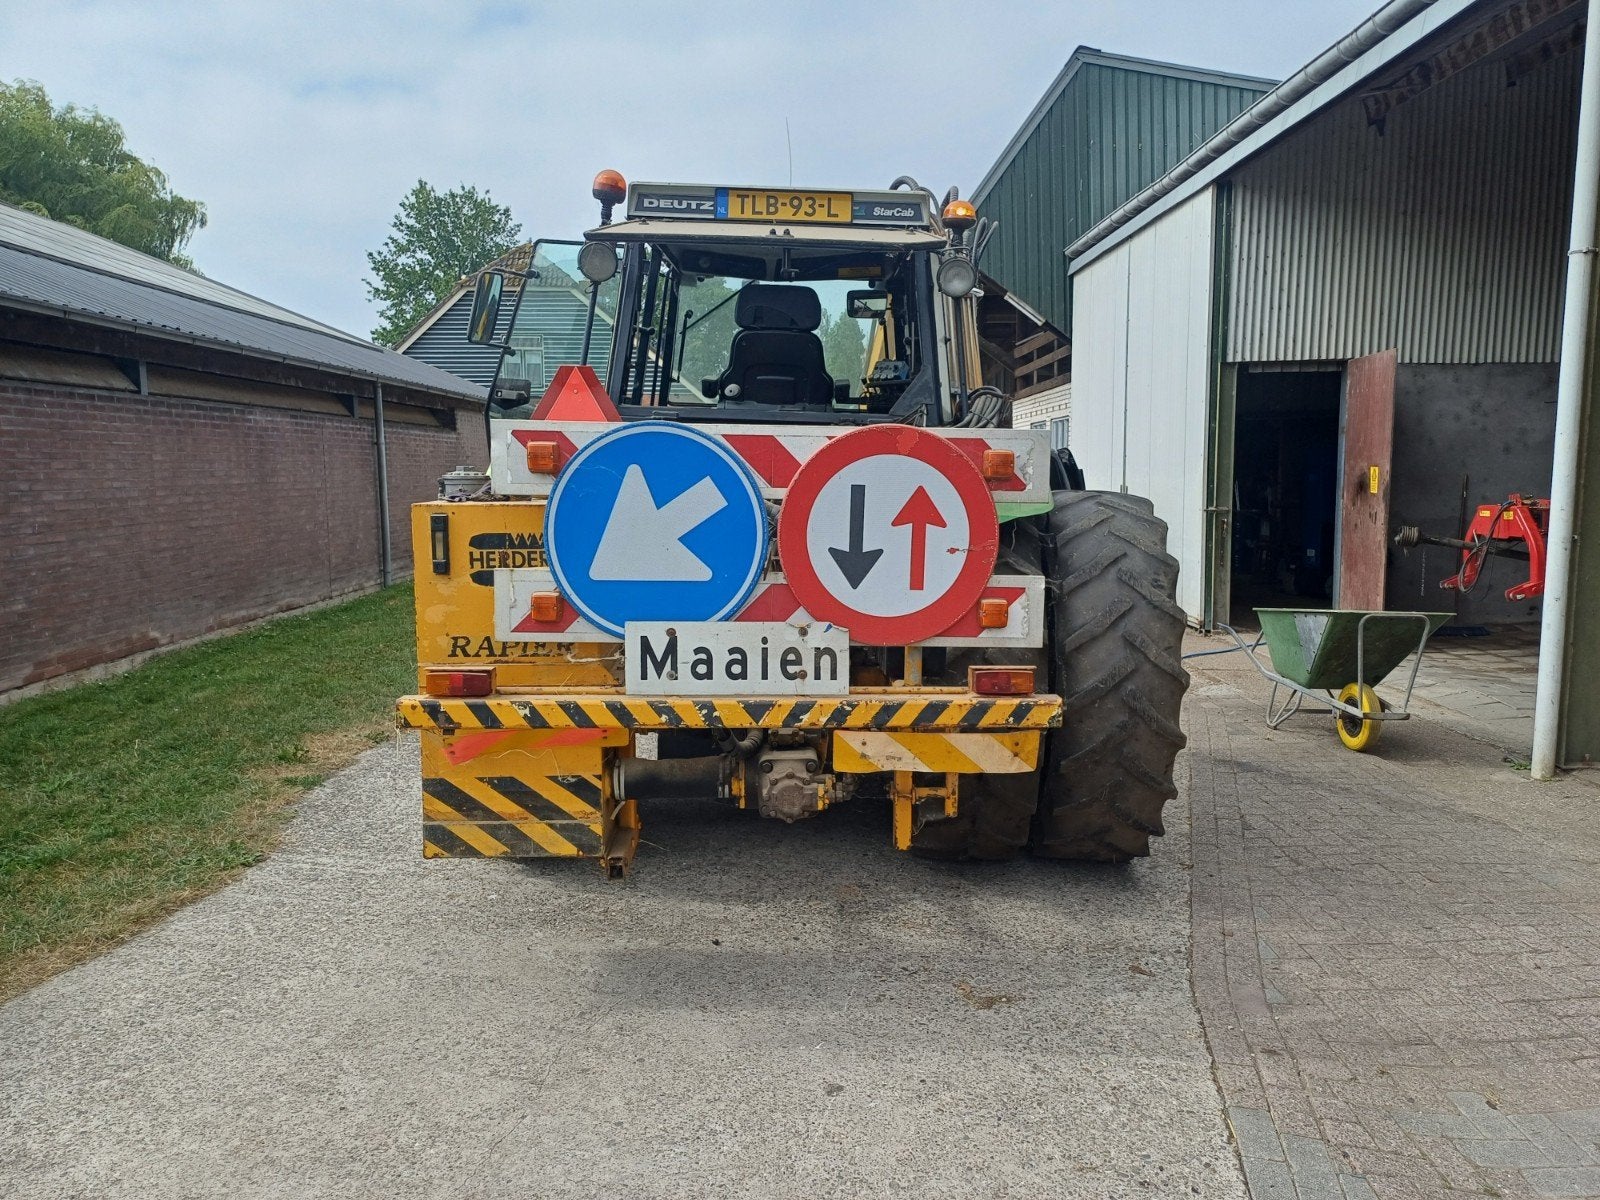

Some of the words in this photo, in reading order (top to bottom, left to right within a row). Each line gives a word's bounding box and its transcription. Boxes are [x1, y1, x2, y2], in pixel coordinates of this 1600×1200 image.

[643, 198, 714, 210] DEUTZ
[717, 206, 727, 214] NL
[736, 193, 839, 219] TLB-93-L
[873, 206, 915, 218] StarCab
[640, 635, 838, 681] Maaien
